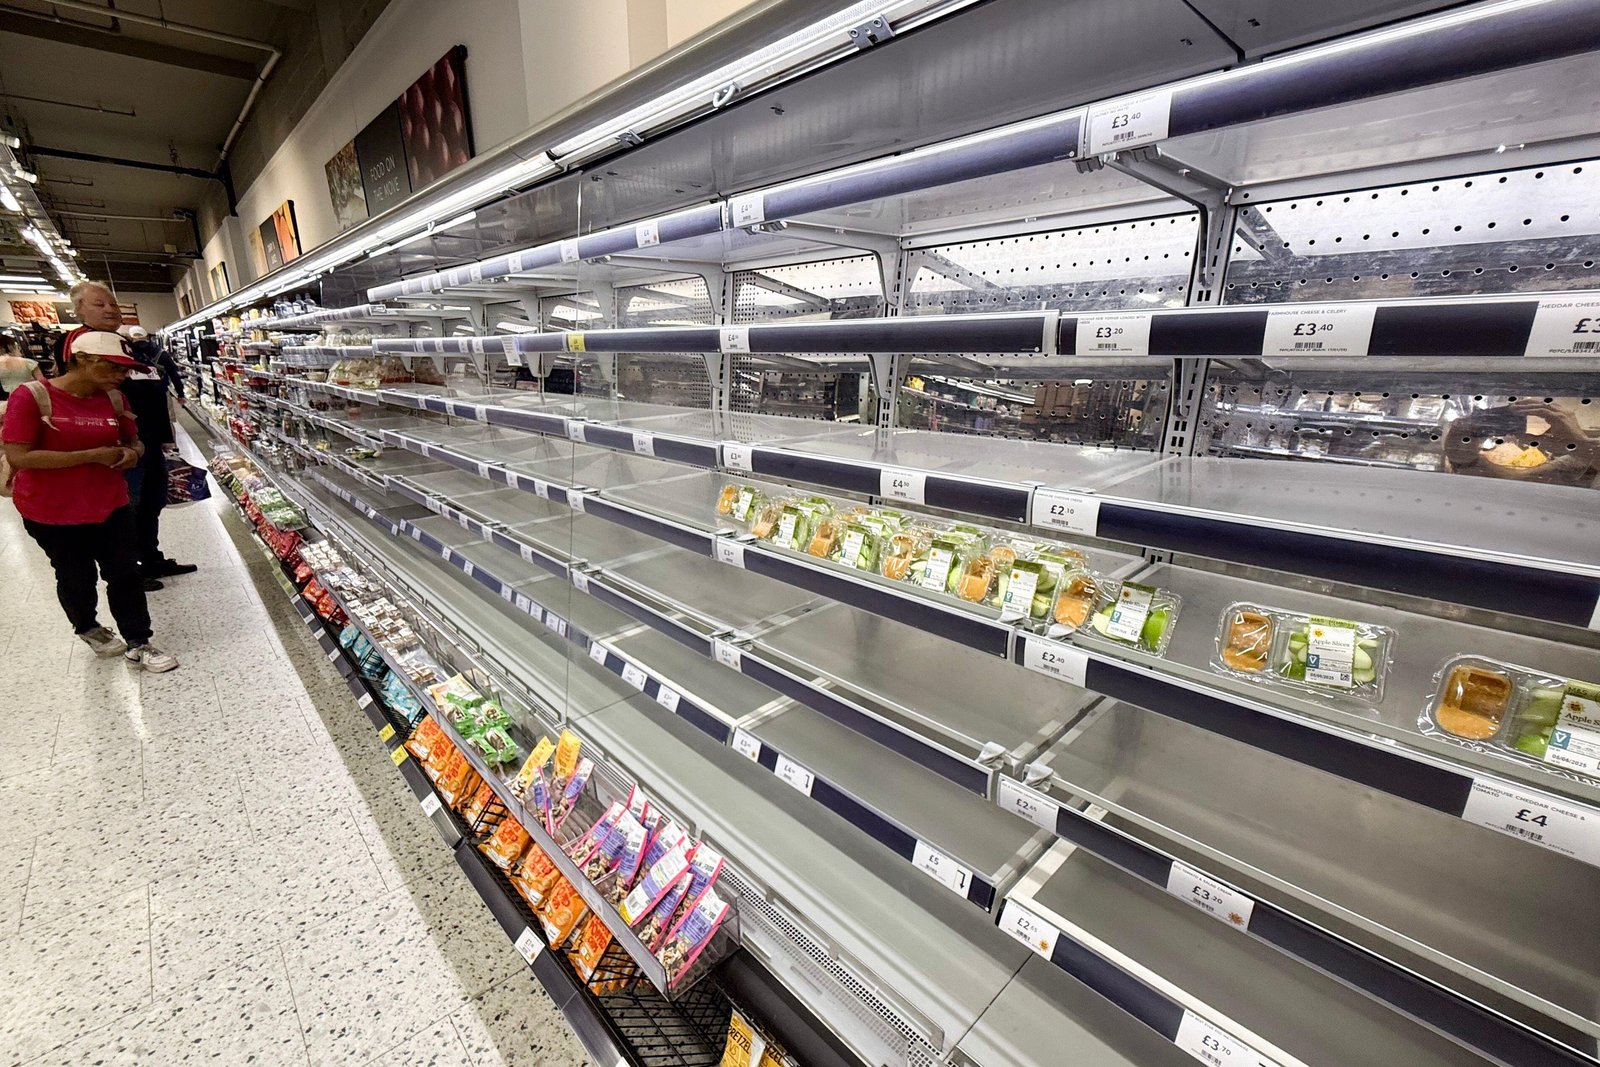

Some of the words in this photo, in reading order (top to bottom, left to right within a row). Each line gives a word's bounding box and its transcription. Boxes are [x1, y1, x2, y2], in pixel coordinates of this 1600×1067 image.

[1112, 112, 1141, 129] £3.40
[370, 162, 385, 182] FOOD
[386, 154, 395, 172] ON
[373, 186, 384, 201] THE
[384, 176, 400, 198] MOVE
[1096, 327, 1123, 338] £3.20
[1293, 323, 1333, 336] £3.40
[1050, 505, 1074, 515] £2.10
[1042, 652, 1065, 664] £2.40
[1565, 713, 1592, 724] Apple
[1472, 786, 1500, 798] TOMATO
[1474, 782, 1514, 798] FARMHOUSE
[1515, 796, 1549, 809] CHEDDAR
[1551, 807, 1577, 818] CHEESE
[1515, 809, 1548, 827] £4
[929, 854, 939, 865] £5
[1192, 886, 1223, 904] £3.20
[1202, 1034, 1232, 1056] £3.70
